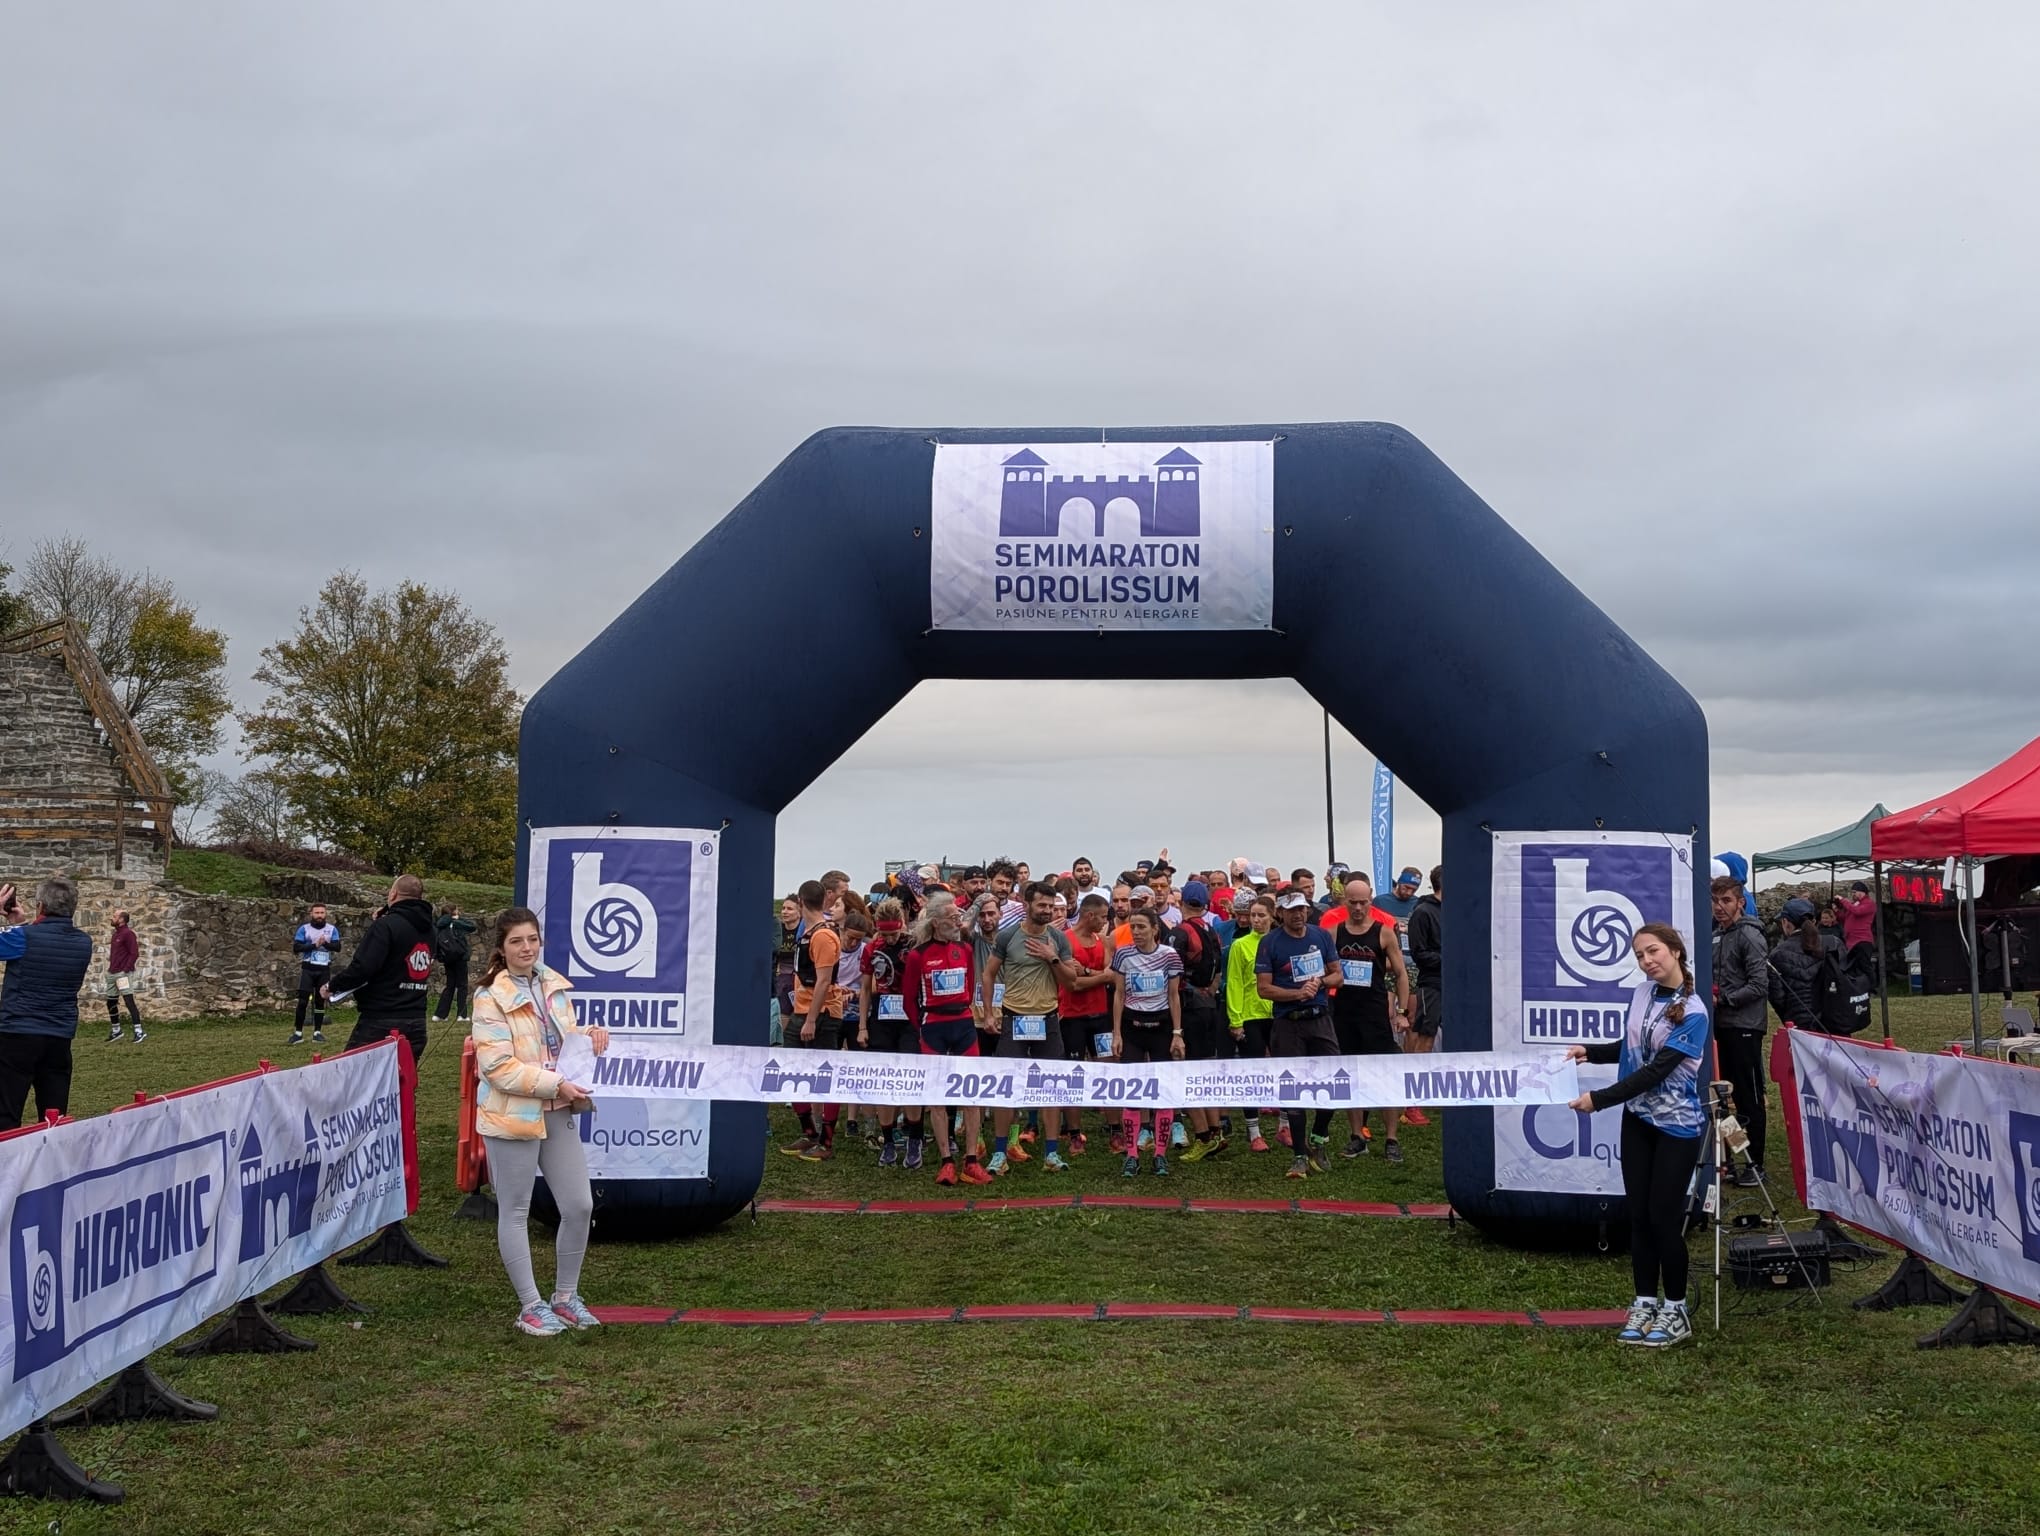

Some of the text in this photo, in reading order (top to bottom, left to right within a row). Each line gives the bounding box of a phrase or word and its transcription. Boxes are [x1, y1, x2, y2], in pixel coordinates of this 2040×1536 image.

[995, 543, 1200, 567] SEMIMARATON
[996, 575, 1199, 603] POROLISSUM
[996, 608, 1200, 619] PASIUNE PENTRU ALERGARE
[576, 999, 678, 1028] DRONIC
[1529, 1008, 1626, 1039] HIDRO
[592, 1056, 704, 1089] MMXXIV
[837, 1077, 925, 1091] POROLISSUM
[839, 1066, 926, 1079] SEMIMARATON
[945, 1073, 1013, 1099] 2024
[1185, 1074, 1274, 1085] SEMIMARATON
[1404, 1069, 1518, 1100] MMXXIV
[1091, 1078, 1160, 1101] 2024
[1185, 1086, 1274, 1097] POROLISSUM
[582, 1118, 702, 1153] quaserv
[1884, 1144, 1996, 1221] POROLISSUM
[1883, 1194, 1922, 1220] PASIUNE
[1945, 1219, 1999, 1249] ALERGARE
[73, 1174, 211, 1303] HIDRONIC
